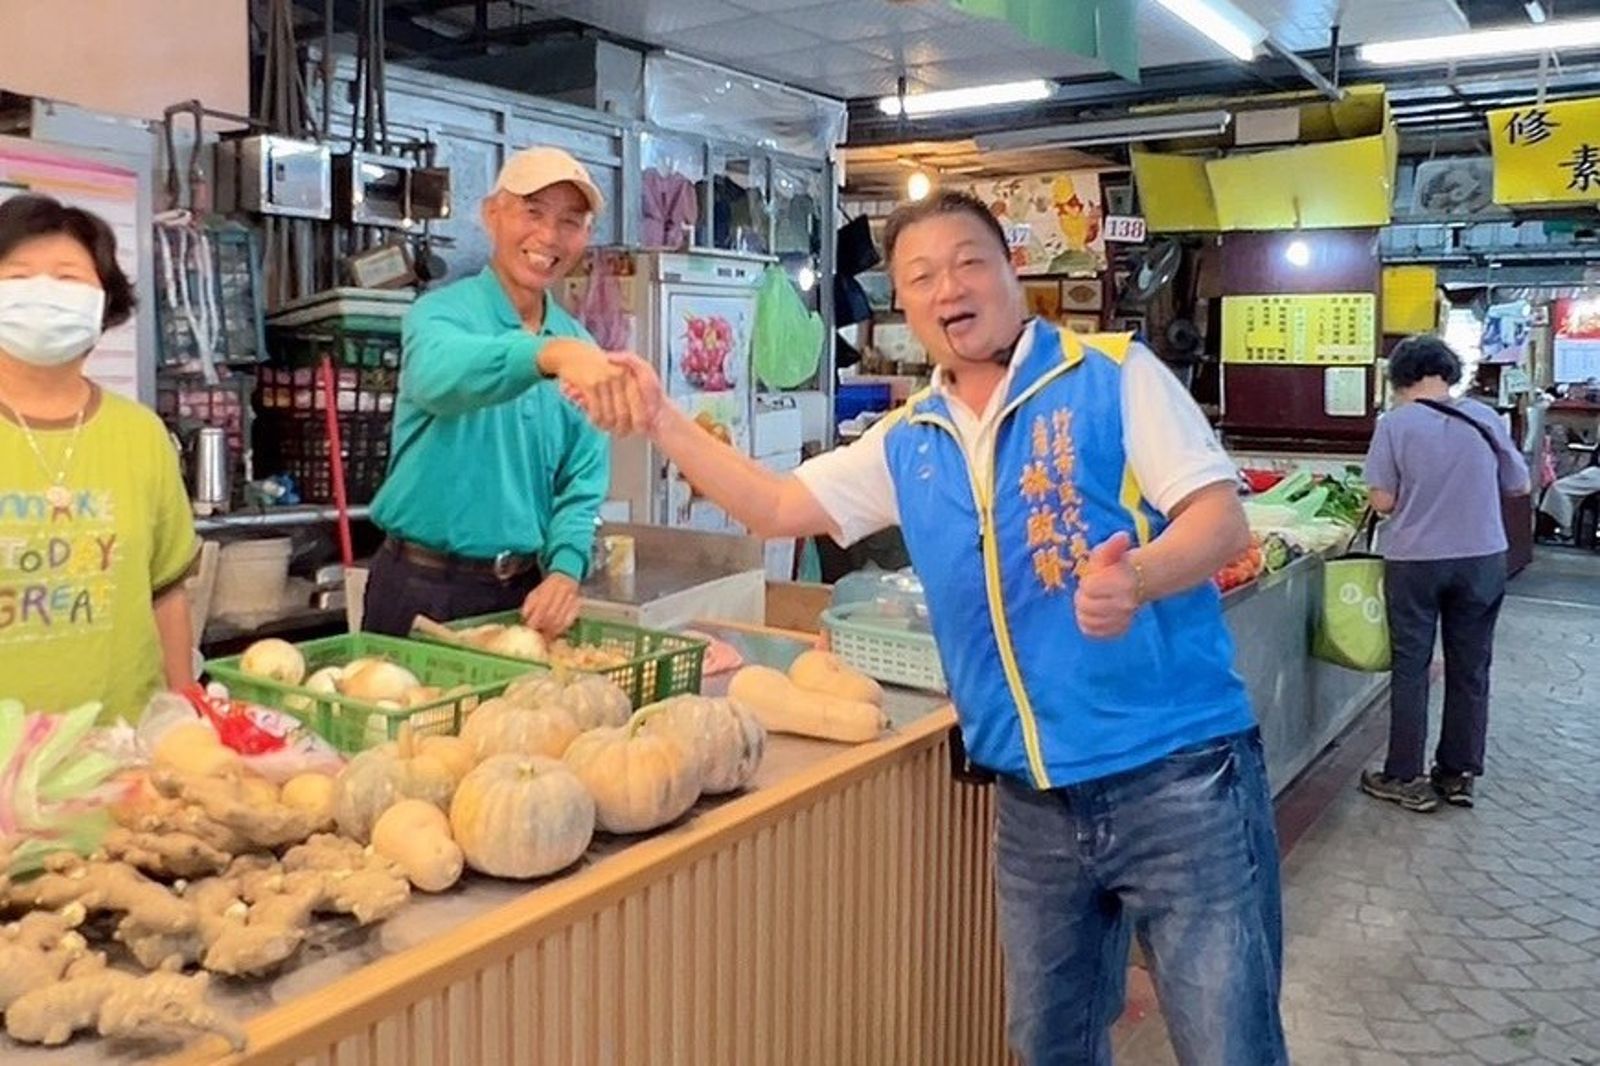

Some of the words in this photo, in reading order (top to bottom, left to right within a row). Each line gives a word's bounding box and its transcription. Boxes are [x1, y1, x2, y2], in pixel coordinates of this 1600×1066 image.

[1502, 108, 1561, 147] 修
[1558, 144, 1600, 191] 素
[1107, 219, 1144, 239] 138
